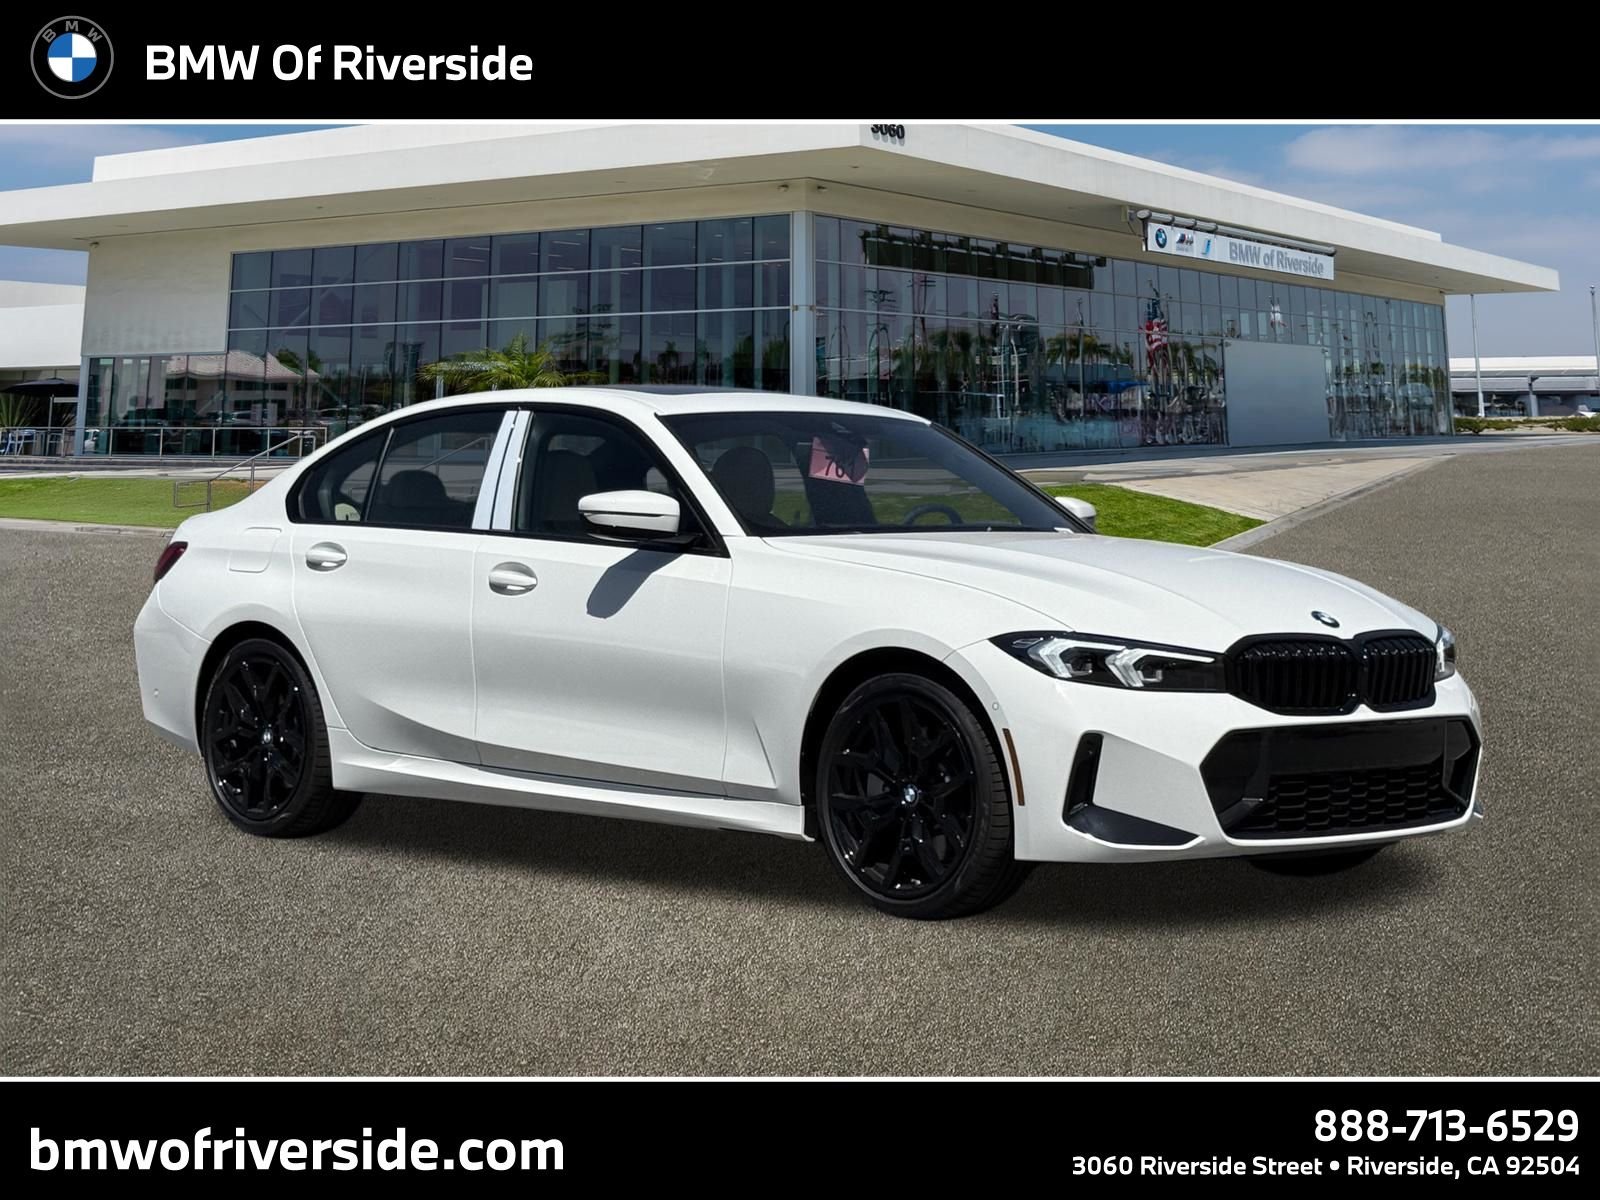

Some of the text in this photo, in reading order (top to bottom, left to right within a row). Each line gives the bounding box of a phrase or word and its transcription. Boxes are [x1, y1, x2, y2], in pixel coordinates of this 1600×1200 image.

[1229, 242, 1261, 265] BMW
[1263, 249, 1275, 268] of
[1277, 251, 1324, 275] Riverside
